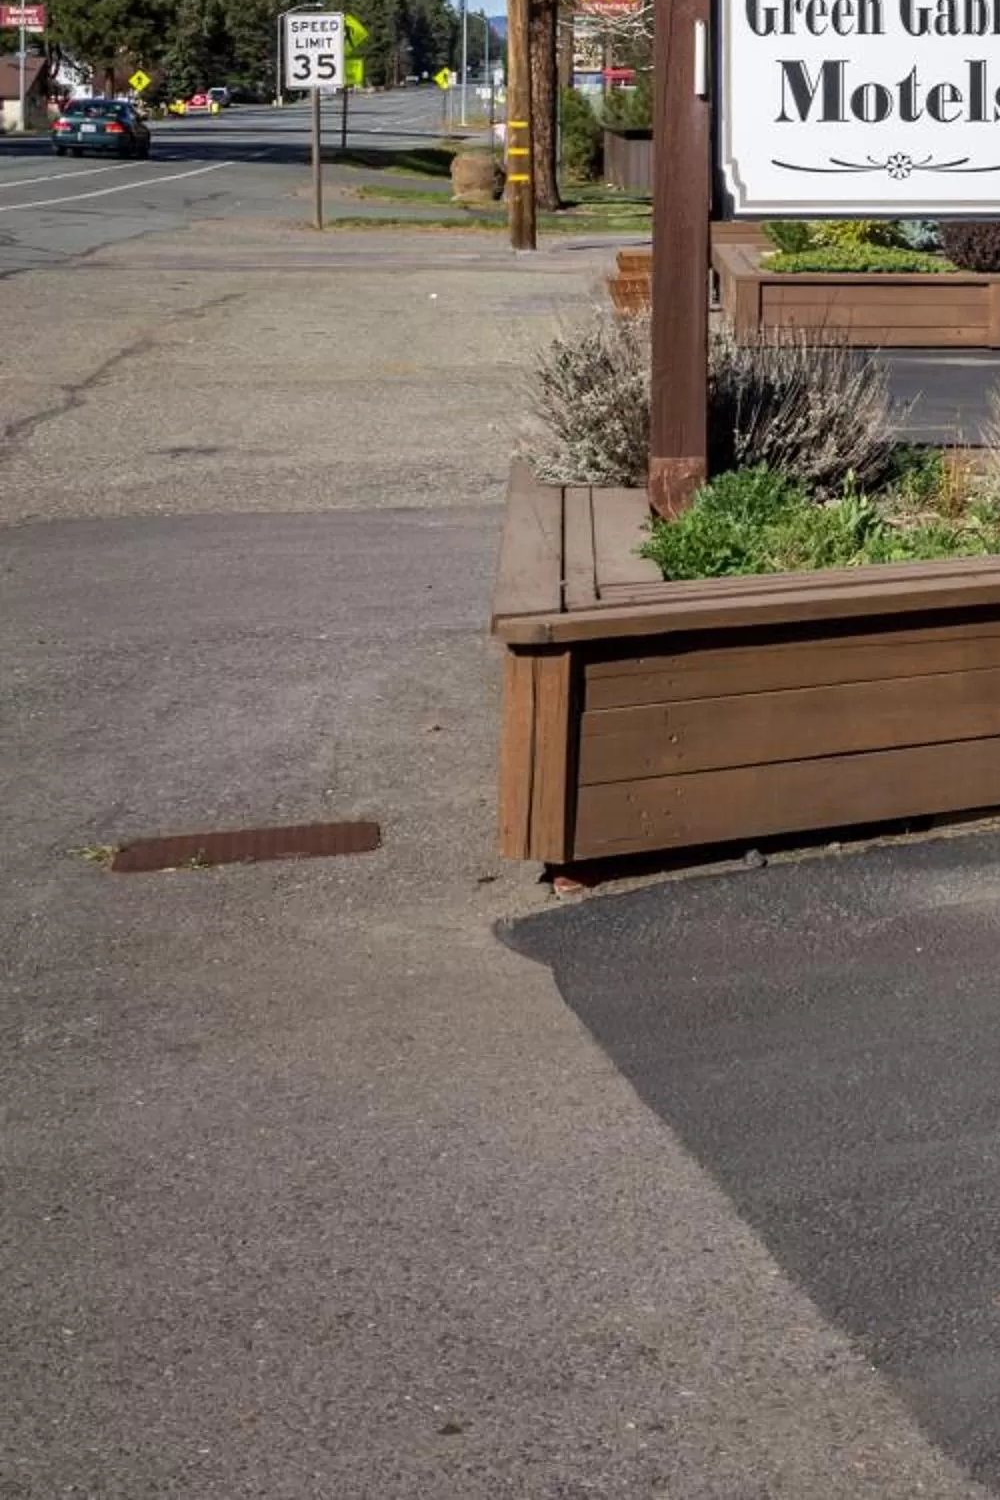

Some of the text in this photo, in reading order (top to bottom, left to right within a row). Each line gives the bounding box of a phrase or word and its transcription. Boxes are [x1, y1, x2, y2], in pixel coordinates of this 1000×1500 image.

[291, 21, 339, 32] SPEED
[295, 38, 333, 48] LIMIT
[292, 54, 336, 80] 35
